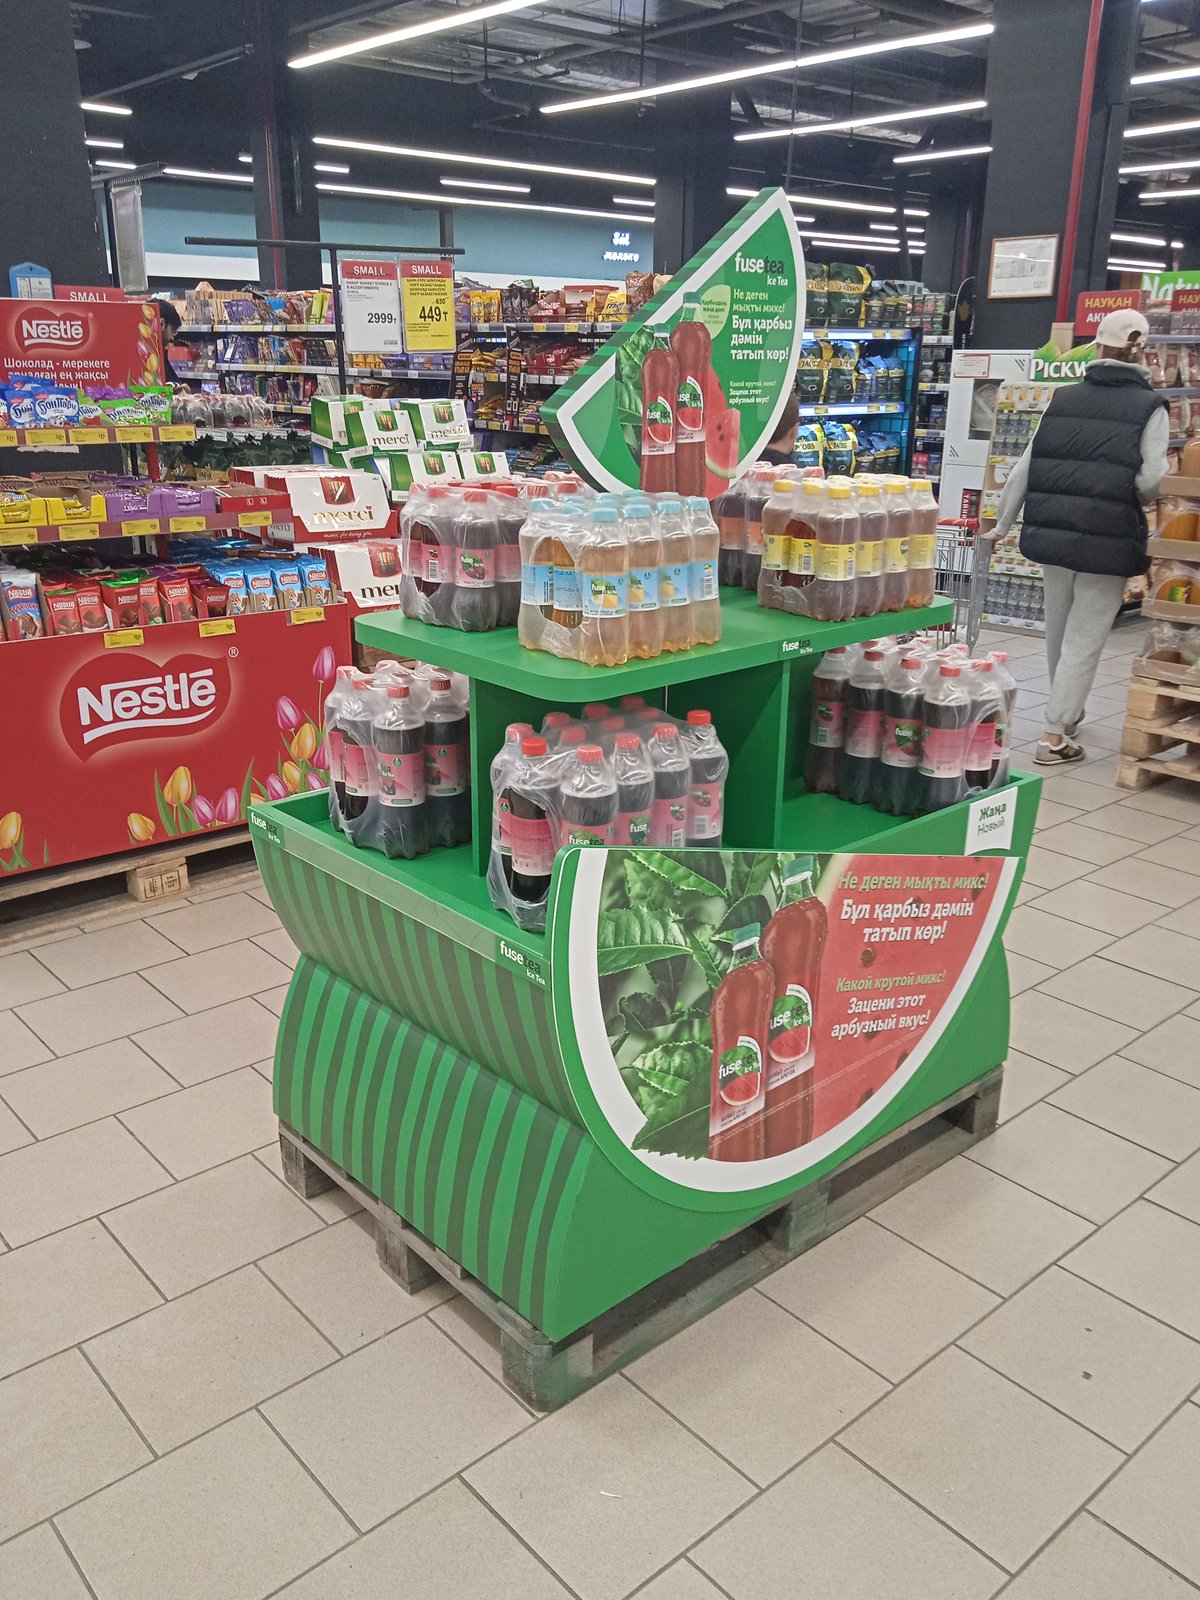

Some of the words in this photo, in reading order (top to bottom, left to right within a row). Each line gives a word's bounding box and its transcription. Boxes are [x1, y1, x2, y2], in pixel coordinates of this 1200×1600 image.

[353, 265, 386, 276] SMALL
[411, 265, 442, 275] SMALL
[767, 275, 776, 286] Ice
[777, 276, 788, 286] Tea
[733, 289, 745, 299] Не
[745, 290, 768, 301] деген
[1085, 297, 1132, 309] НАУҚАН
[732, 304, 762, 314] мықты
[762, 304, 785, 313] микс!
[732, 315, 752, 331] Бұл
[754, 316, 793, 332] қарбыз
[731, 332, 762, 346] дәмін
[730, 349, 764, 360] татып
[766, 347, 789, 363] көр!
[4, 357, 54, 368] Шоколад
[62, 359, 110, 371] мерекеге
[60, 371, 74, 382] ең
[74, 371, 109, 382] жақсы
[373, 434, 410, 445] merci
[313, 507, 374, 525] merci
[979, 803, 1007, 822] Жаңа
[976, 818, 1006, 836] Новый
[838, 871, 858, 890] Не
[860, 874, 902, 892] деген
[903, 872, 952, 892] мықты
[953, 872, 990, 890] микс!
[841, 900, 870, 923] Бұл
[872, 898, 930, 922] қарбыз
[931, 898, 974, 918] дәмін
[862, 924, 912, 944] татып
[914, 920, 948, 944] көр!
[500, 940, 541, 974] fusetea
[526, 968, 536, 980] Ice
[535, 974, 546, 986] Tea
[836, 975, 873, 992] Какой
[874, 972, 916, 990] крутой
[916, 970, 947, 986] микс!
[848, 996, 894, 1016] Зацени
[896, 993, 927, 1008] этот
[831, 1017, 897, 1040] арбузный
[898, 1010, 931, 1031] вкус!
